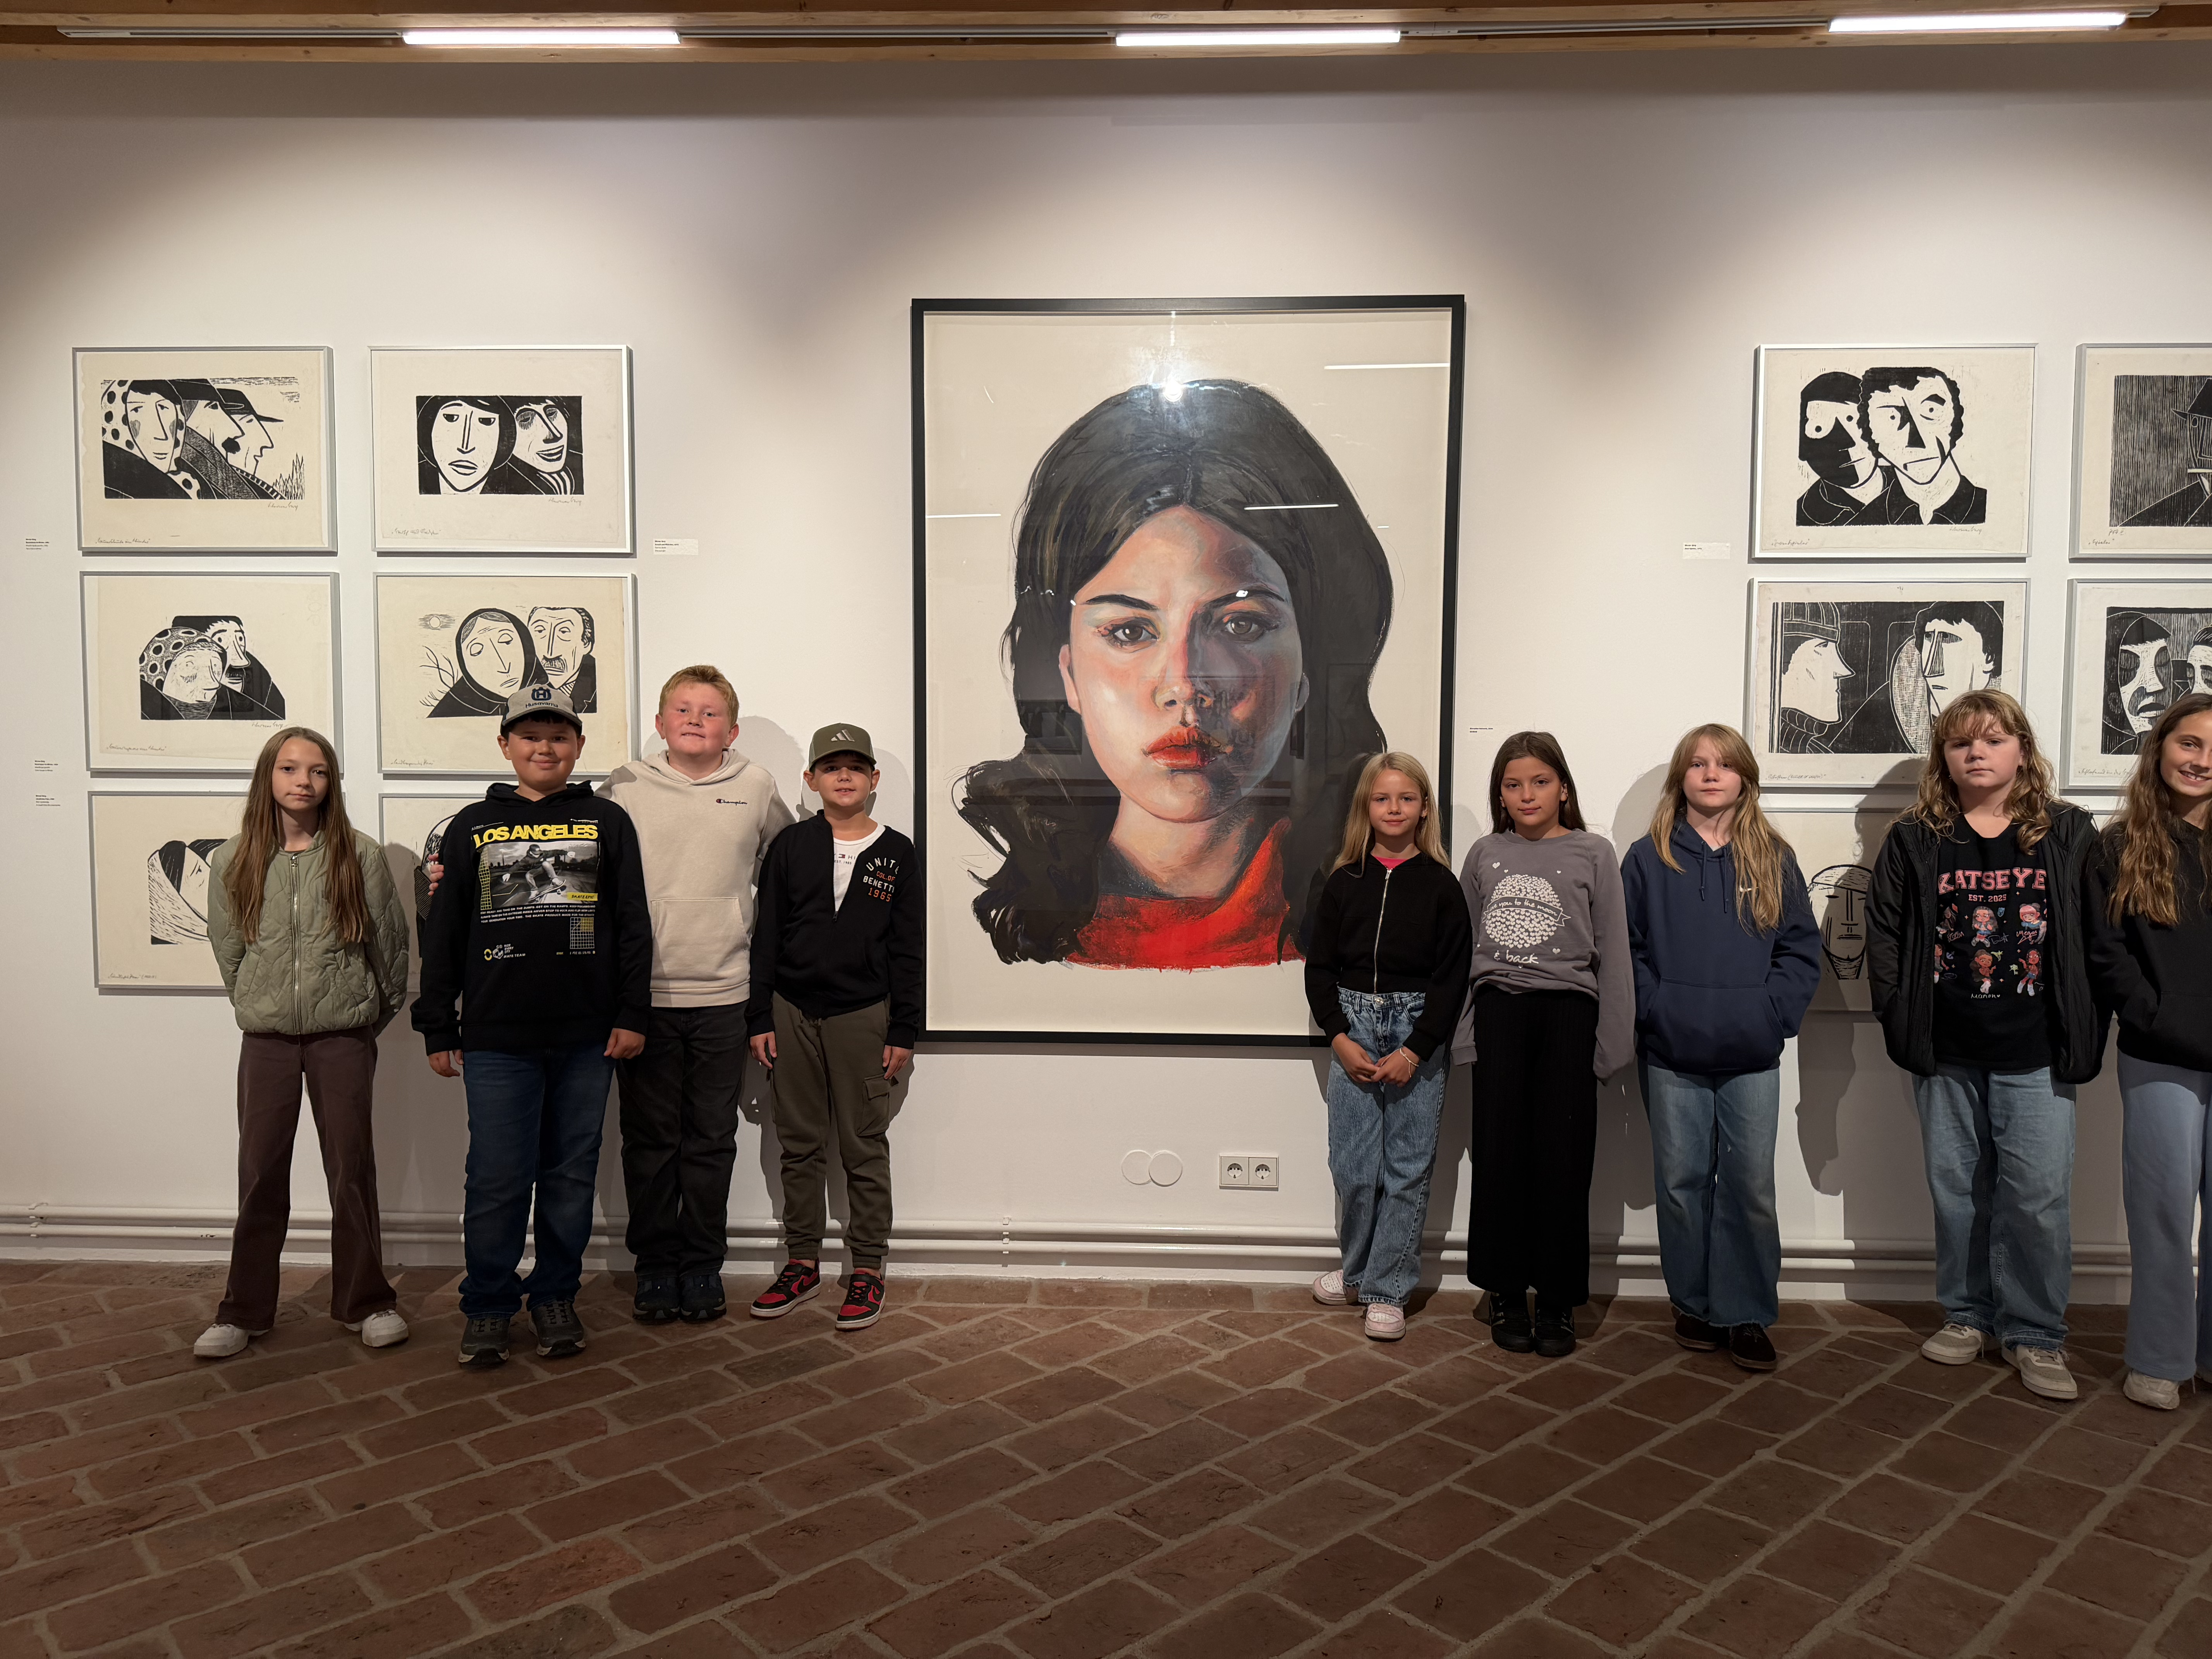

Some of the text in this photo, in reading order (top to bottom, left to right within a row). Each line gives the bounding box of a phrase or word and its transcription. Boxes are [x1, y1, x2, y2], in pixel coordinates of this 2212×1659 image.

[473, 824, 598, 848] LOS ANGELES
[1938, 867, 2047, 895] KATSEYE
[868, 888, 892, 902] 1965
[1968, 894, 1986, 902] EST.
[1524, 899, 1535, 907] the
[1537, 905, 1558, 916] moon
[1494, 950, 1539, 964] & back
